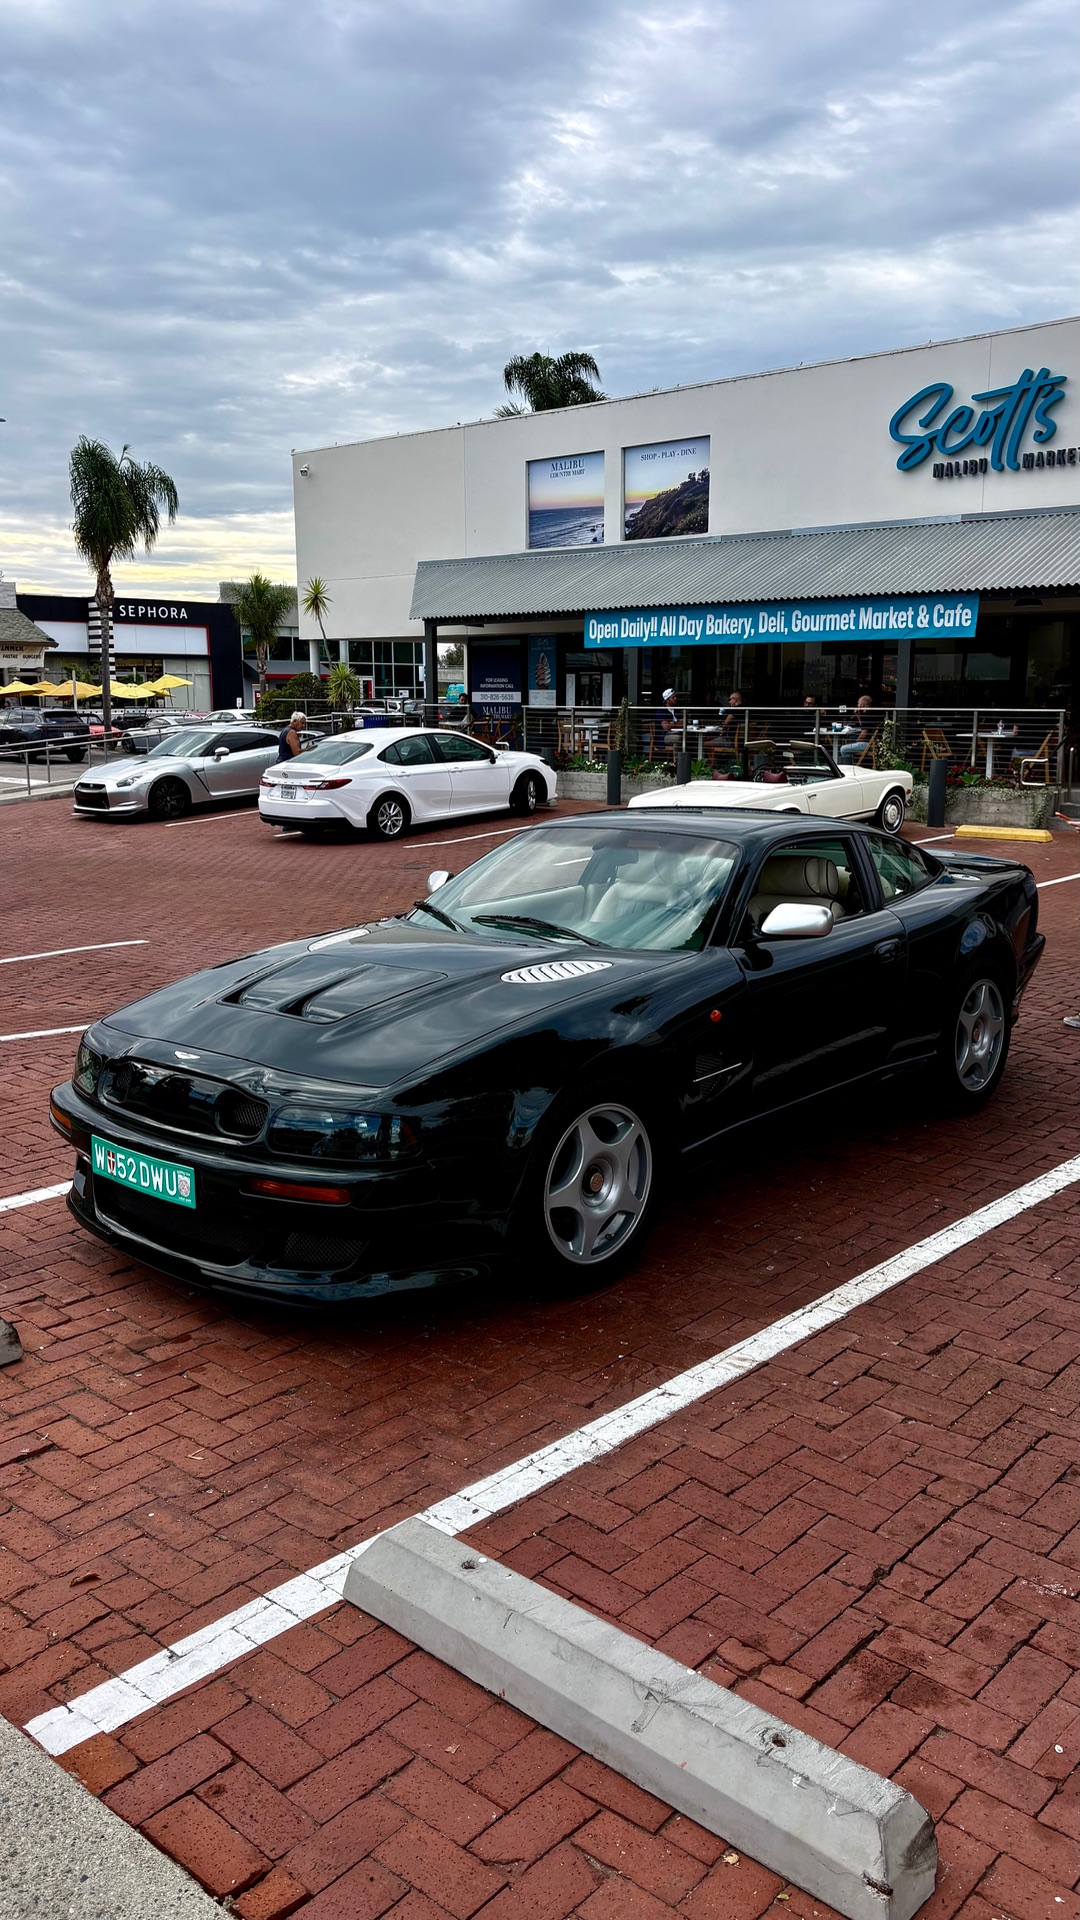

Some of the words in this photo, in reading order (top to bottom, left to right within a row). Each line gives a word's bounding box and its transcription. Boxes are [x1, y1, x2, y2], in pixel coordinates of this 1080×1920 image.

[889, 367, 1067, 471] Scott's
[641, 453, 658, 461] SHOP
[661, 450, 676, 459] PLAY
[680, 447, 697, 456] DINE
[550, 458, 585, 471] MALIBU
[571, 468, 586, 476] MART
[932, 458, 988, 478] MALIBU
[119, 604, 188, 619] SEPHORA
[589, 619, 618, 643] Open
[620, 616, 657, 642] Daily!!
[660, 615, 676, 637] All
[678, 615, 704, 641] Day
[705, 613, 754, 639] Bakery,
[758, 610, 788, 635] Deli,
[791, 609, 856, 633] Gourmet
[859, 606, 914, 629] Market
[916, 604, 930, 628] &
[933, 603, 972, 628] Cafe
[483, 706, 512, 714] MALIBU
[95, 1143, 105, 1170] W
